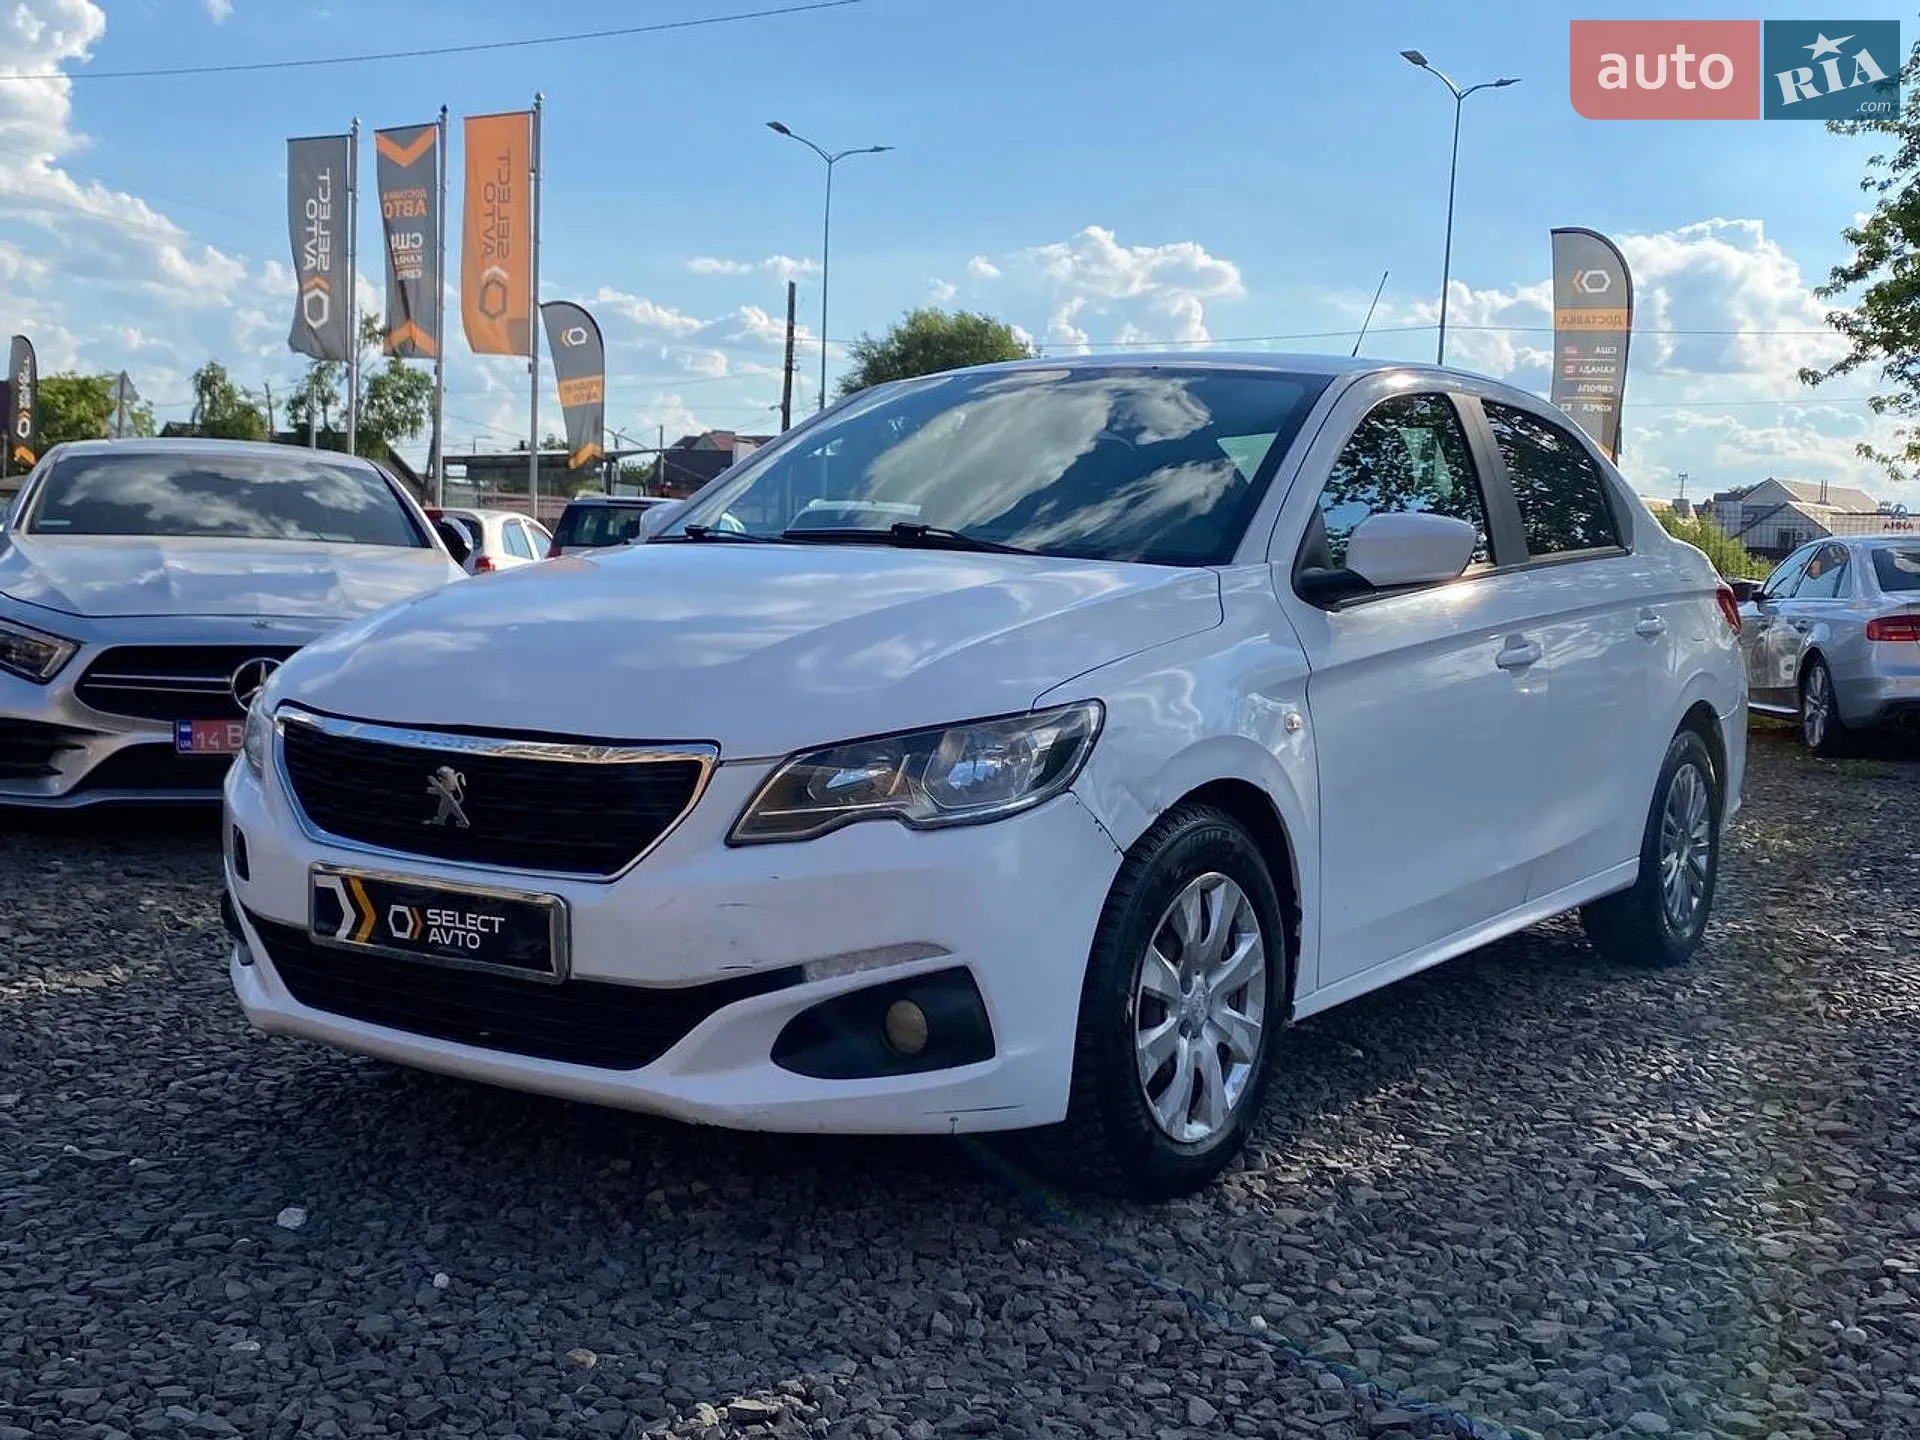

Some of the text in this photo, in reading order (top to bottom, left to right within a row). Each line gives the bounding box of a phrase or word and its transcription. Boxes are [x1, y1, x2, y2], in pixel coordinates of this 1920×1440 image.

[195, 731, 220, 750] 14
[426, 908, 505, 934] SELECT
[428, 927, 480, 949] AVTO
